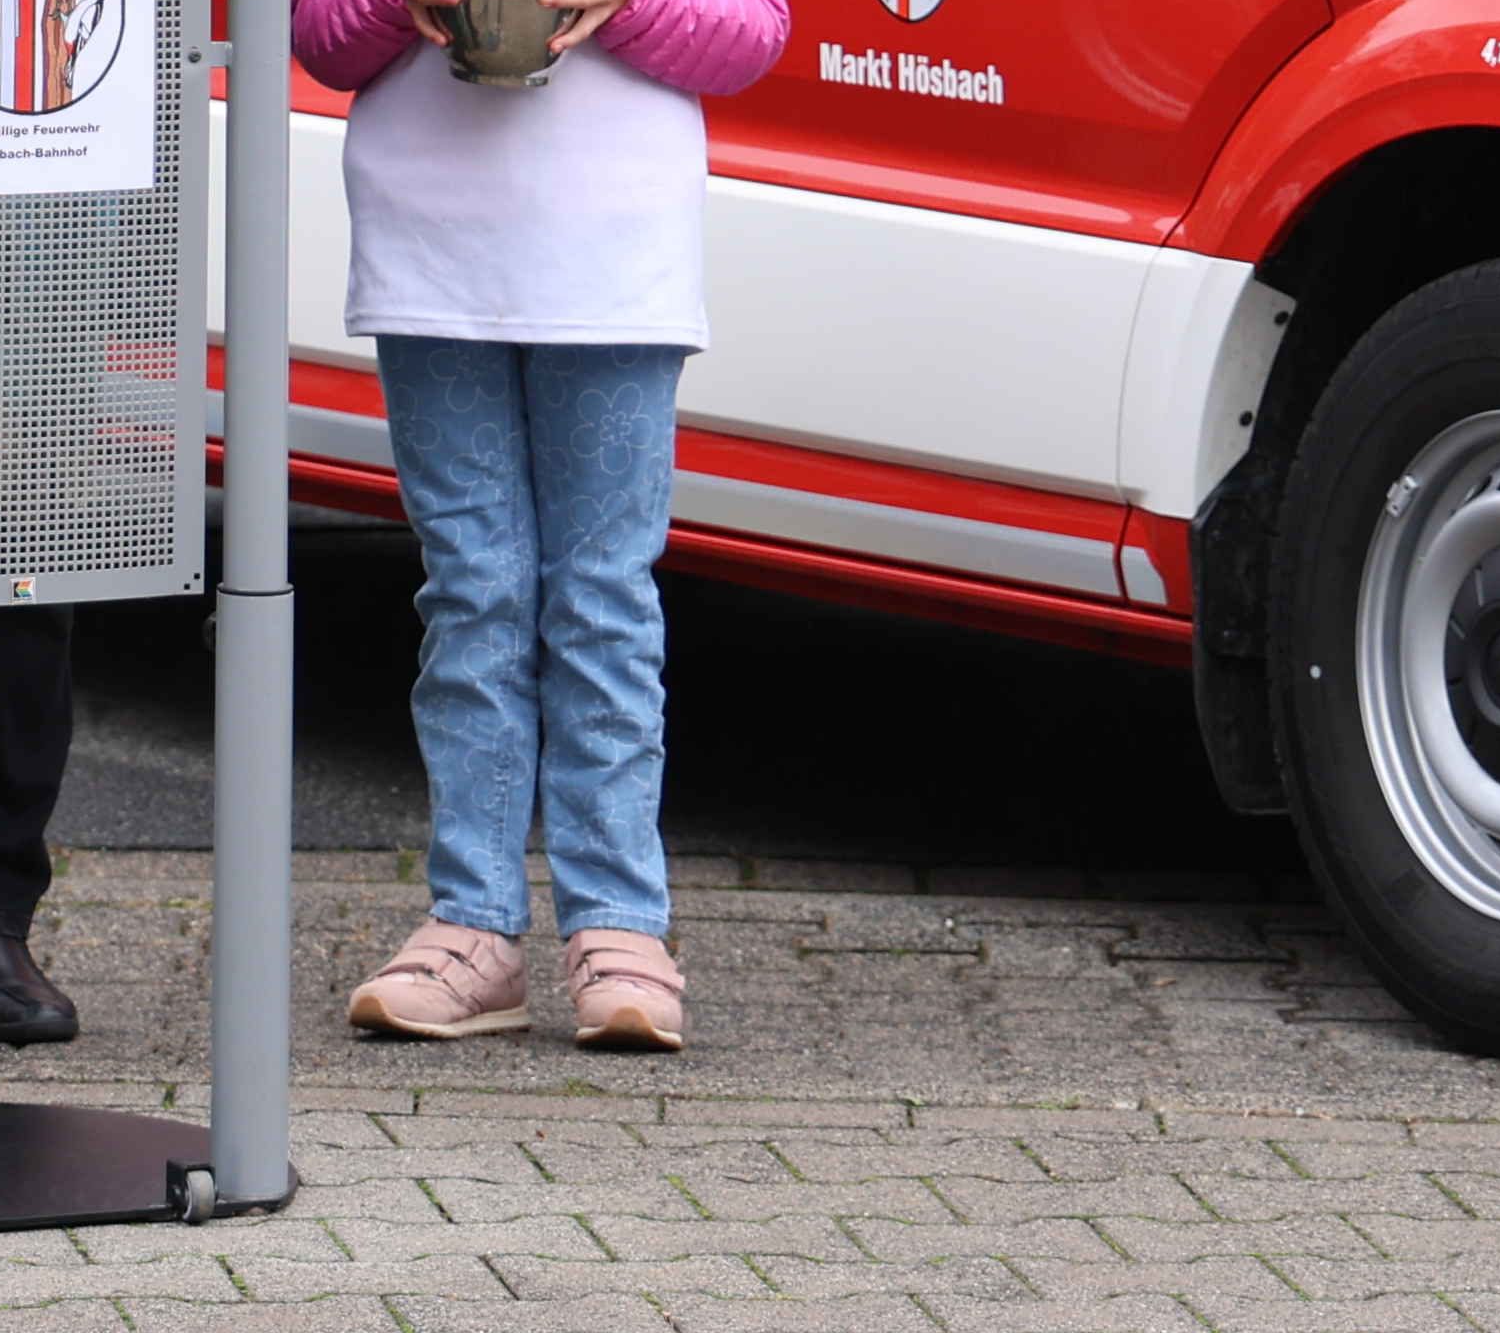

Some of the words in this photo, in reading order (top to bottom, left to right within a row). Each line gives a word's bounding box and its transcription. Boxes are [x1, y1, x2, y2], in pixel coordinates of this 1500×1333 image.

[820, 42, 893, 90] Markt
[897, 53, 1005, 105] Hösbach
[33, 123, 101, 136] Feuerwehr
